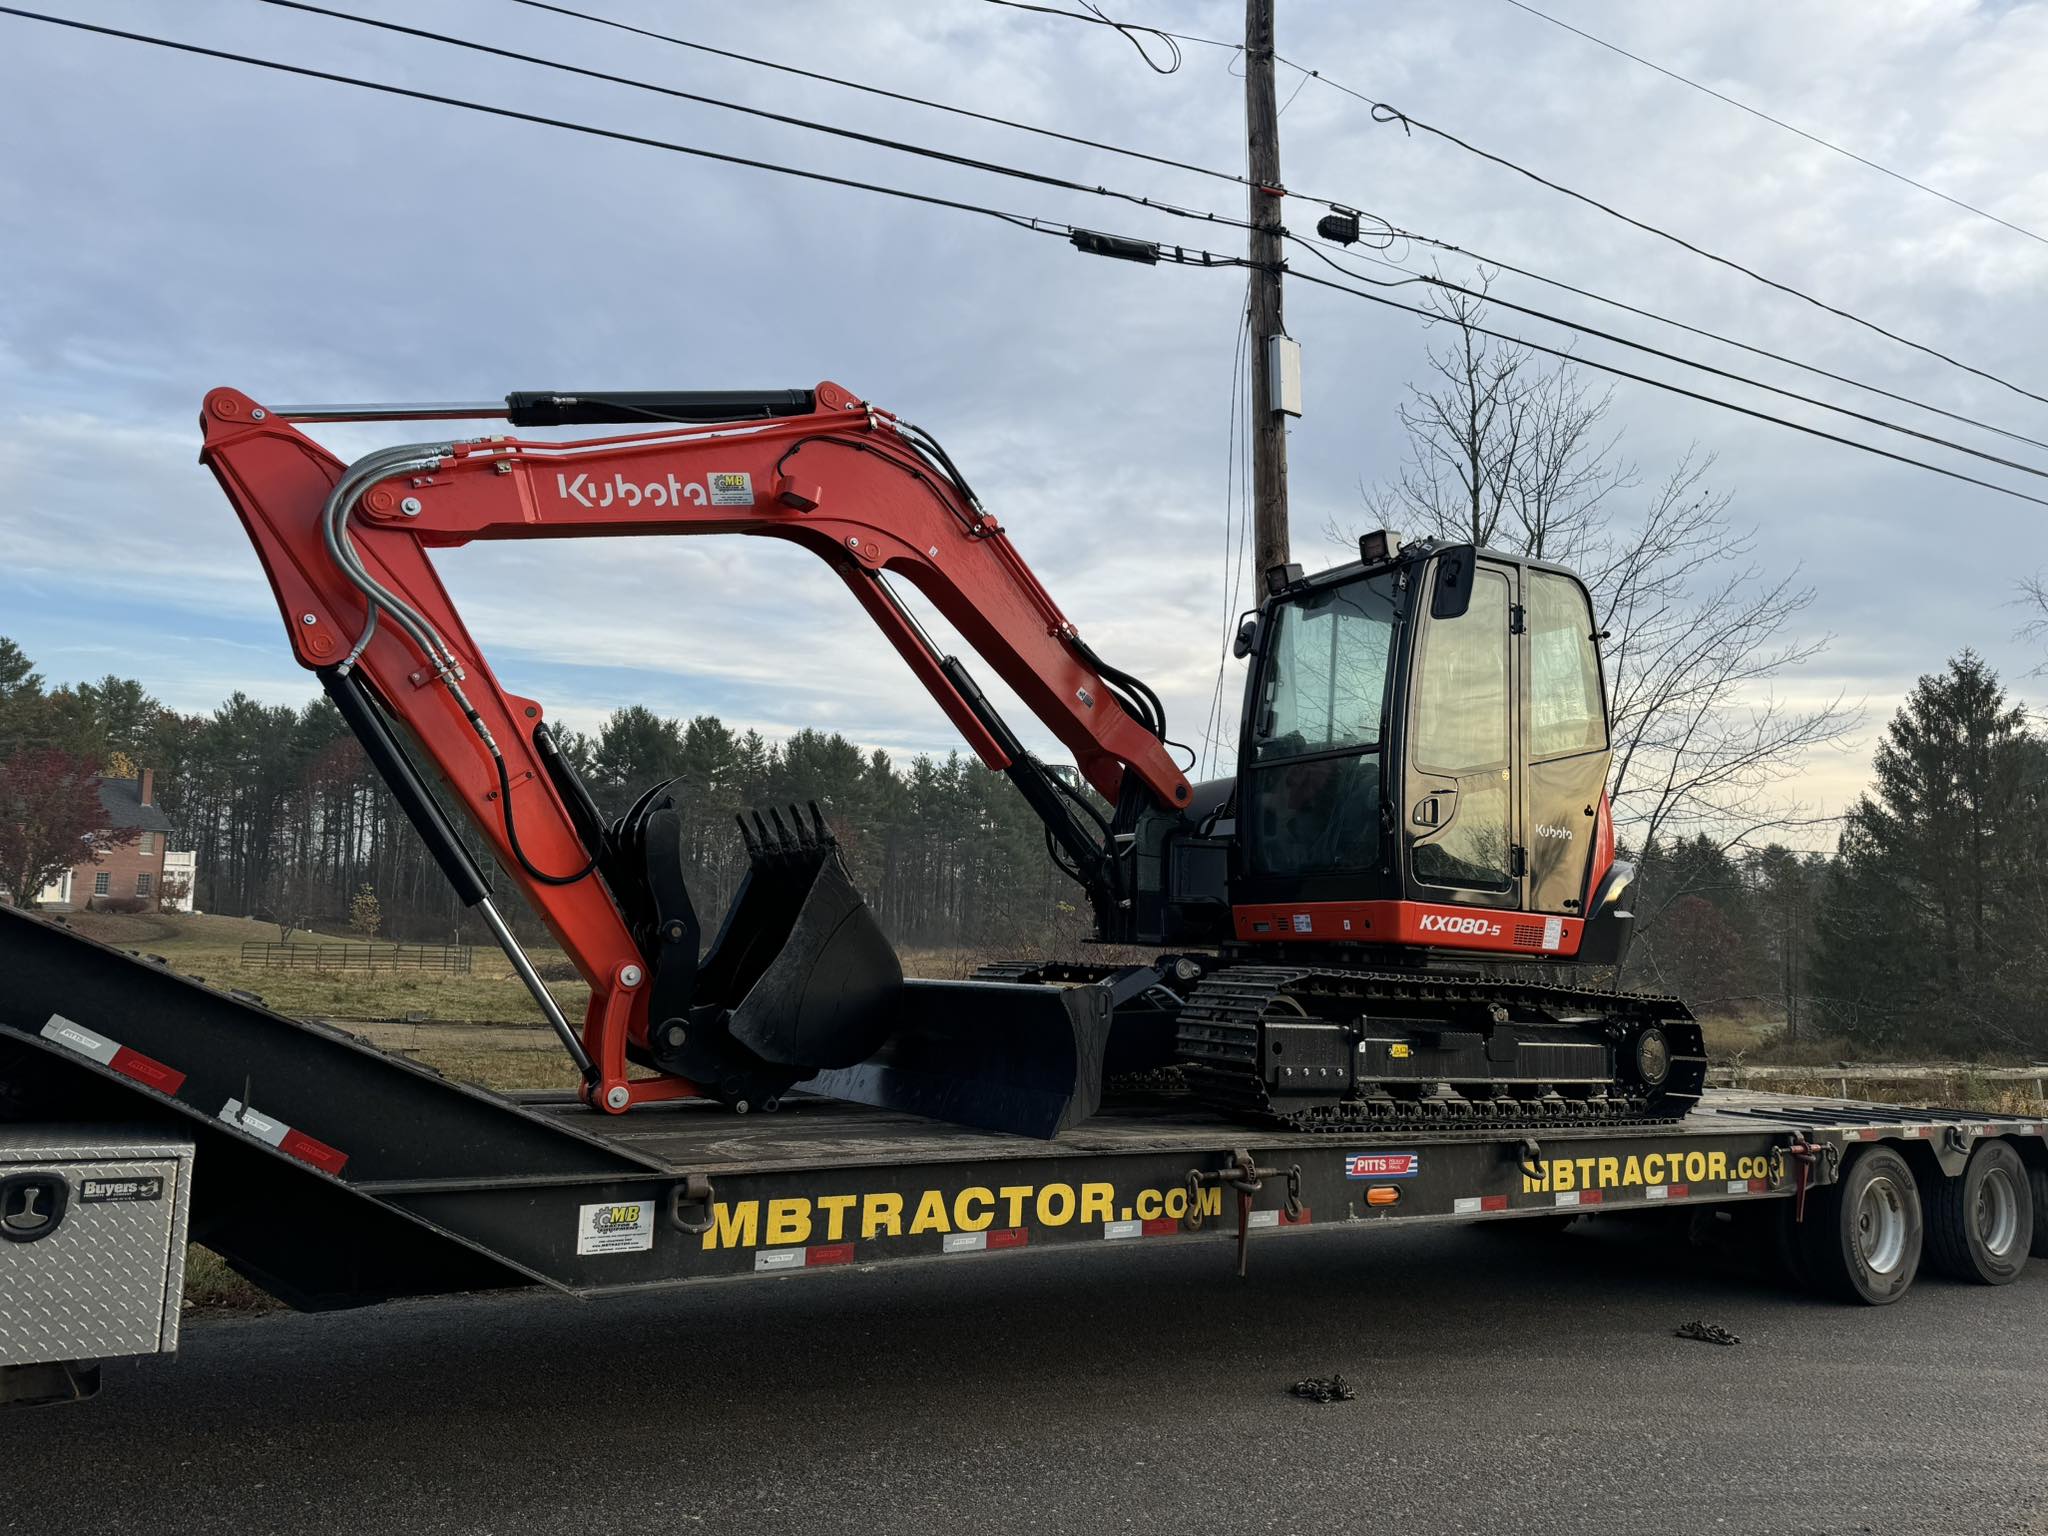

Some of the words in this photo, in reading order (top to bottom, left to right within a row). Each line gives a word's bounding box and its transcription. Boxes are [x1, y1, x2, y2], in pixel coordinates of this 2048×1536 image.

[724, 474, 745, 487] MB
[556, 473, 708, 507] Kubota
[1535, 823, 1574, 841] Kubota
[1419, 914, 1502, 936] KX080-5
[1356, 1158, 1387, 1172] PITTS
[1522, 1151, 1785, 1194] MBTRACTOR.CO
[84, 1181, 138, 1197] Buyers
[610, 1205, 640, 1224] MB
